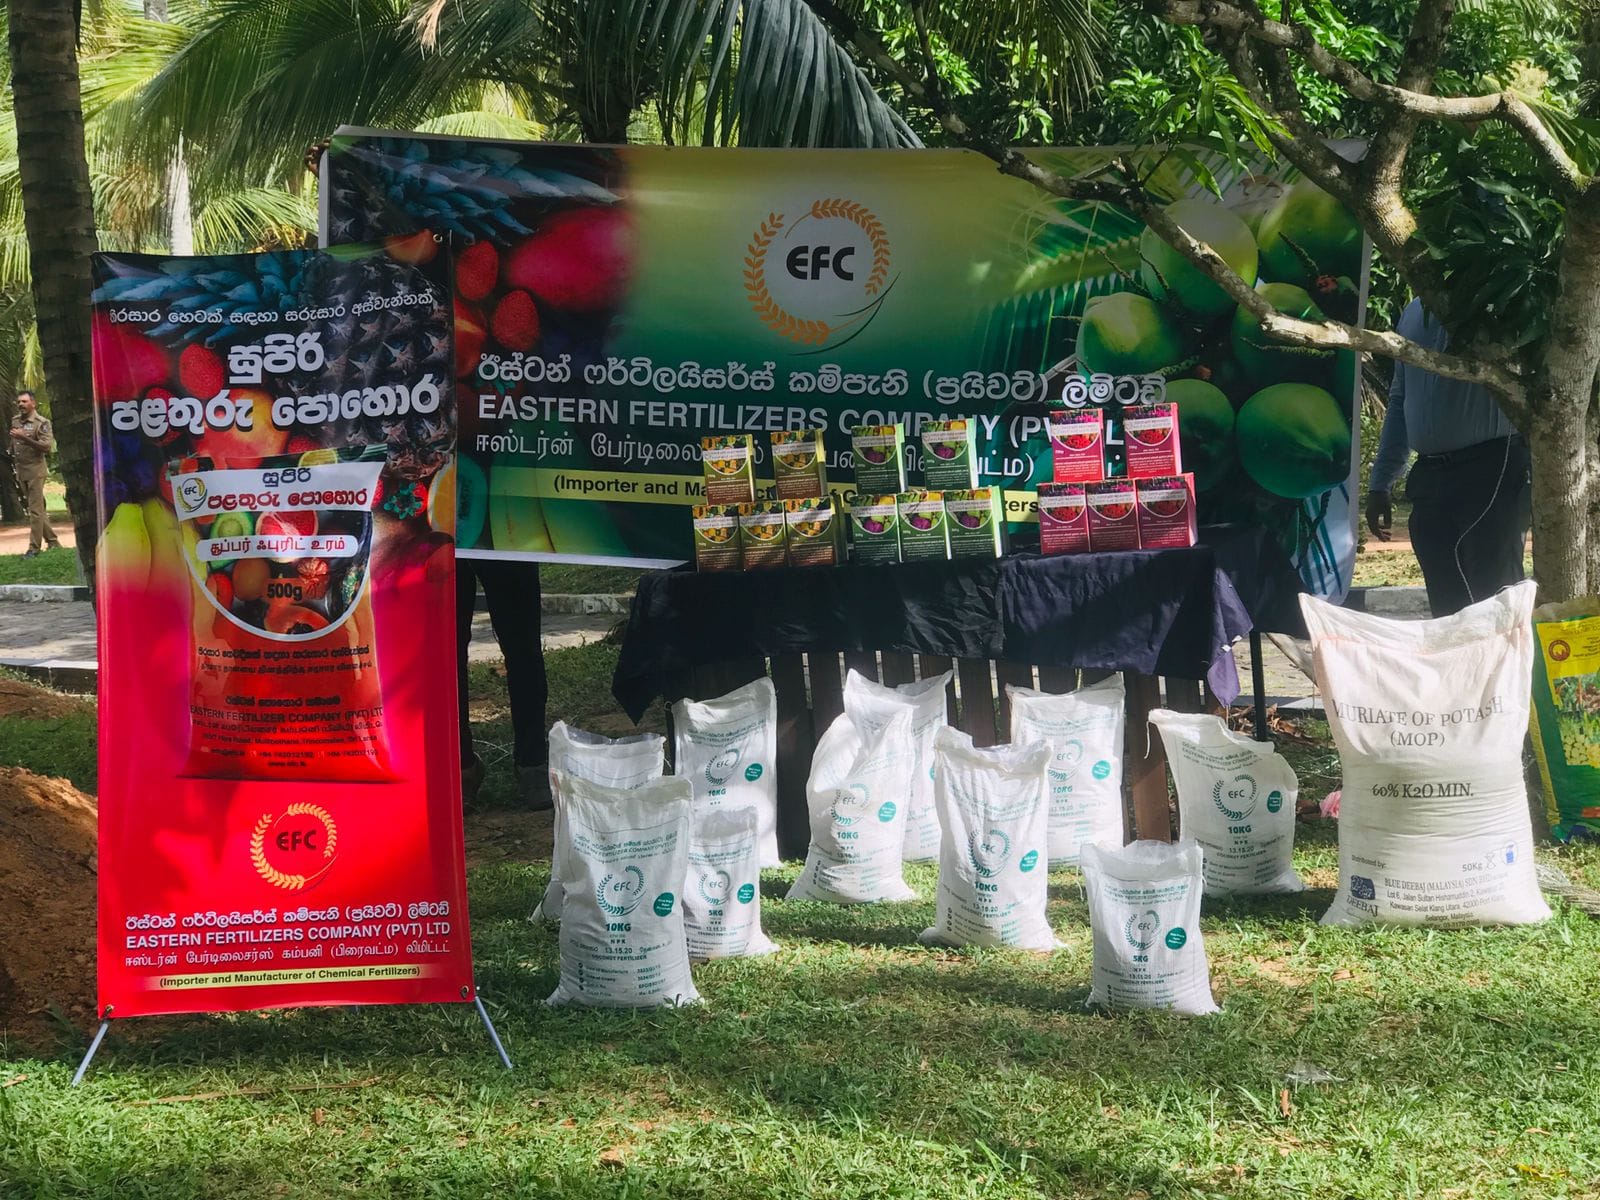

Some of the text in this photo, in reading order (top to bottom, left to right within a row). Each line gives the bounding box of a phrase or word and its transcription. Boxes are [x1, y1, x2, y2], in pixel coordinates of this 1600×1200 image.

[786, 245, 855, 281] EFC
[168, 308, 223, 323] හෙටක්
[228, 331, 325, 384] සුපිරි
[789, 363, 909, 398] කම්පැනි
[111, 373, 440, 438] පළතුරු පොහොර
[478, 394, 619, 425] EASTERN
[629, 402, 828, 433] FERTILIZERS
[554, 474, 637, 496] (Importer
[644, 476, 679, 496] and
[267, 583, 303, 600] 500g
[1411, 711, 1435, 727] OF
[1441, 696, 1503, 727] POTASH
[1391, 732, 1445, 747] (MOP)
[1228, 789, 1245, 799] EFC
[1372, 783, 1399, 798] 60%
[1438, 782, 1474, 797] MIN.
[837, 831, 859, 840] 10KG
[1228, 825, 1252, 834] 10KG
[276, 829, 317, 851] EFC
[613, 881, 631, 892] EFC
[974, 881, 998, 892] 10KG
[708, 909, 723, 917] 5KG
[1347, 895, 1379, 917] DEEBAJ
[126, 922, 450, 949] EASTERN FERTILIZERS COMPANY (PVT) LTD
[605, 922, 631, 932] 10KG
[160, 966, 420, 988] (Importer and Manufacturer of Chemical Fertilizers)
